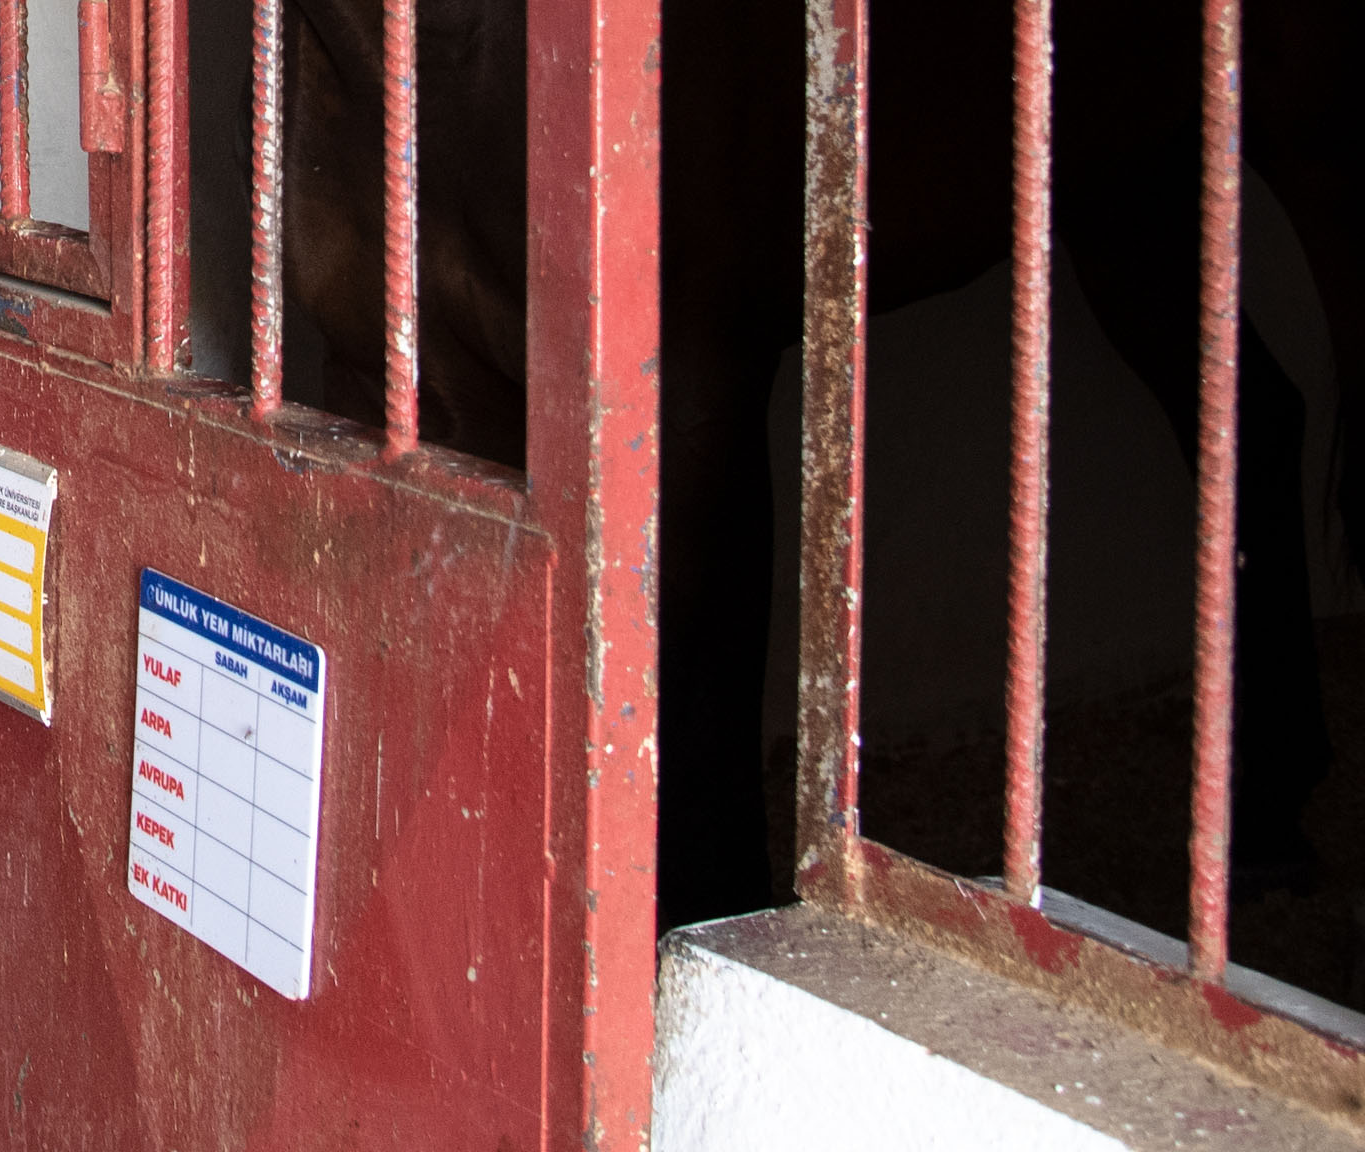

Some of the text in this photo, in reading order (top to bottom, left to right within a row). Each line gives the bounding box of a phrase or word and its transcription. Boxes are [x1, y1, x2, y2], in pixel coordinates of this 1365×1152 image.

[4, 487, 40, 510] ÜNİVERSİTESİ
[6, 500, 39, 522] BAŞKANLIĞI
[201, 609, 229, 638] YEM
[232, 622, 313, 680] MİKTARLARI
[143, 653, 182, 688] YULAF
[215, 651, 308, 710] SABAH AKŞAM
[140, 707, 173, 739] ARPA
[138, 759, 185, 801] AVRUPA
[136, 811, 175, 851] KEPEK
[133, 863, 188, 913] EK KATKI
